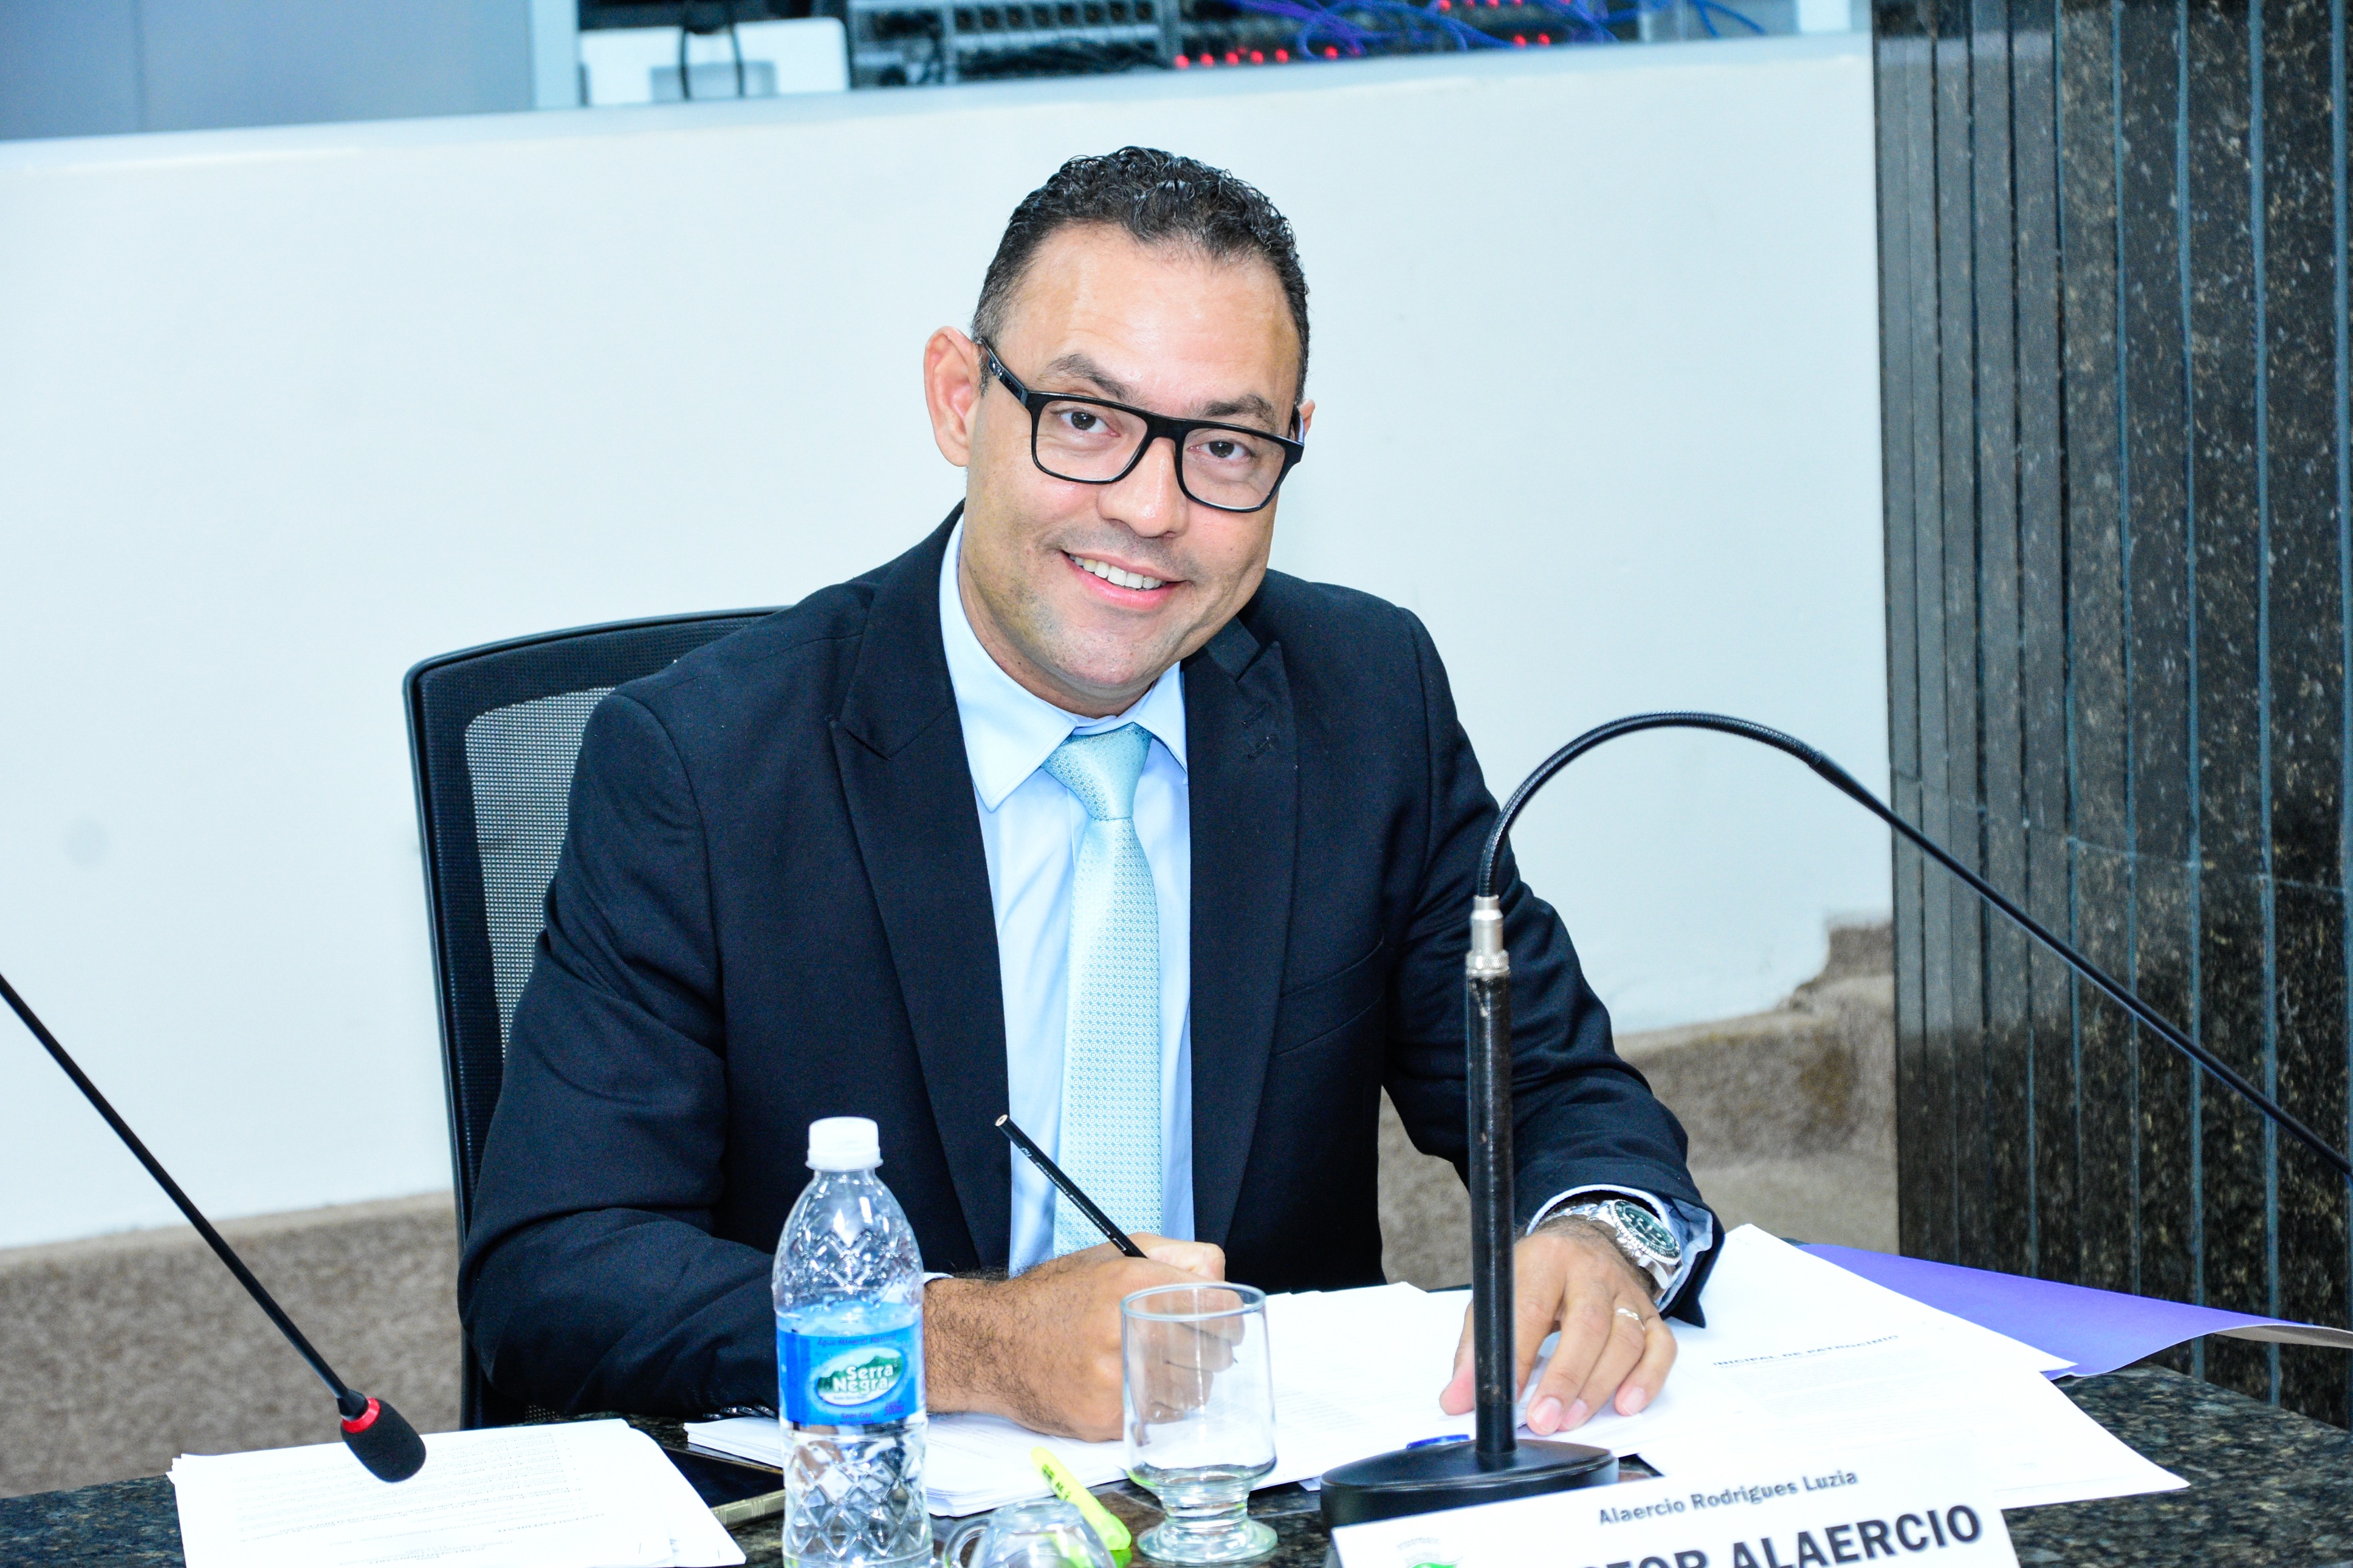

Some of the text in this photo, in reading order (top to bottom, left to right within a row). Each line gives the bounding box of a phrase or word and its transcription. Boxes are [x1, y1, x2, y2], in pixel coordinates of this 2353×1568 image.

[833, 1377, 888, 1395] Negra
[846, 1365, 893, 1381] Serra
[1598, 1470, 1858, 1525] Alaercio Rodrigues Luzia
[1732, 1505, 1982, 1568] ALAERCIO
